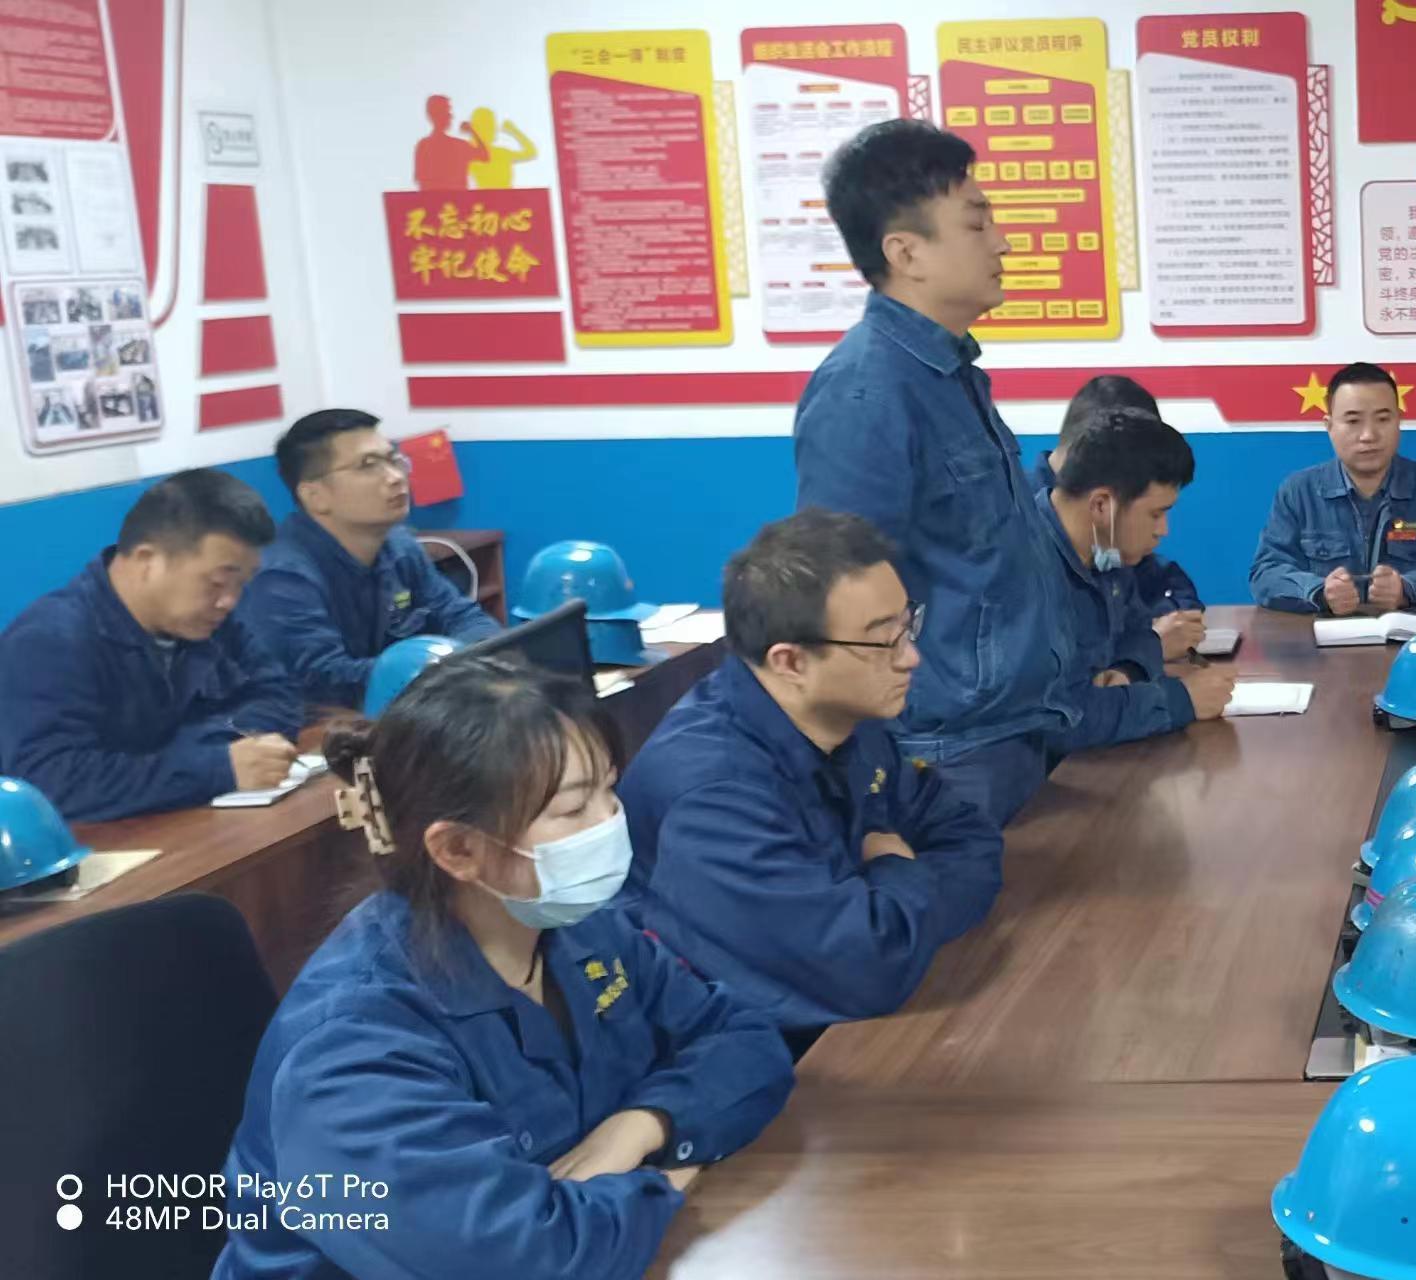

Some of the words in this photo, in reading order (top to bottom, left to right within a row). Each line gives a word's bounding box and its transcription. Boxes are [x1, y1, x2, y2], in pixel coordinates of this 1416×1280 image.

[957, 35, 1083, 54] 民主评议党员程序
[1181, 28, 1260, 49] 党员权利
[404, 203, 533, 240] 不忘初心
[409, 244, 540, 285] 牢记使命
